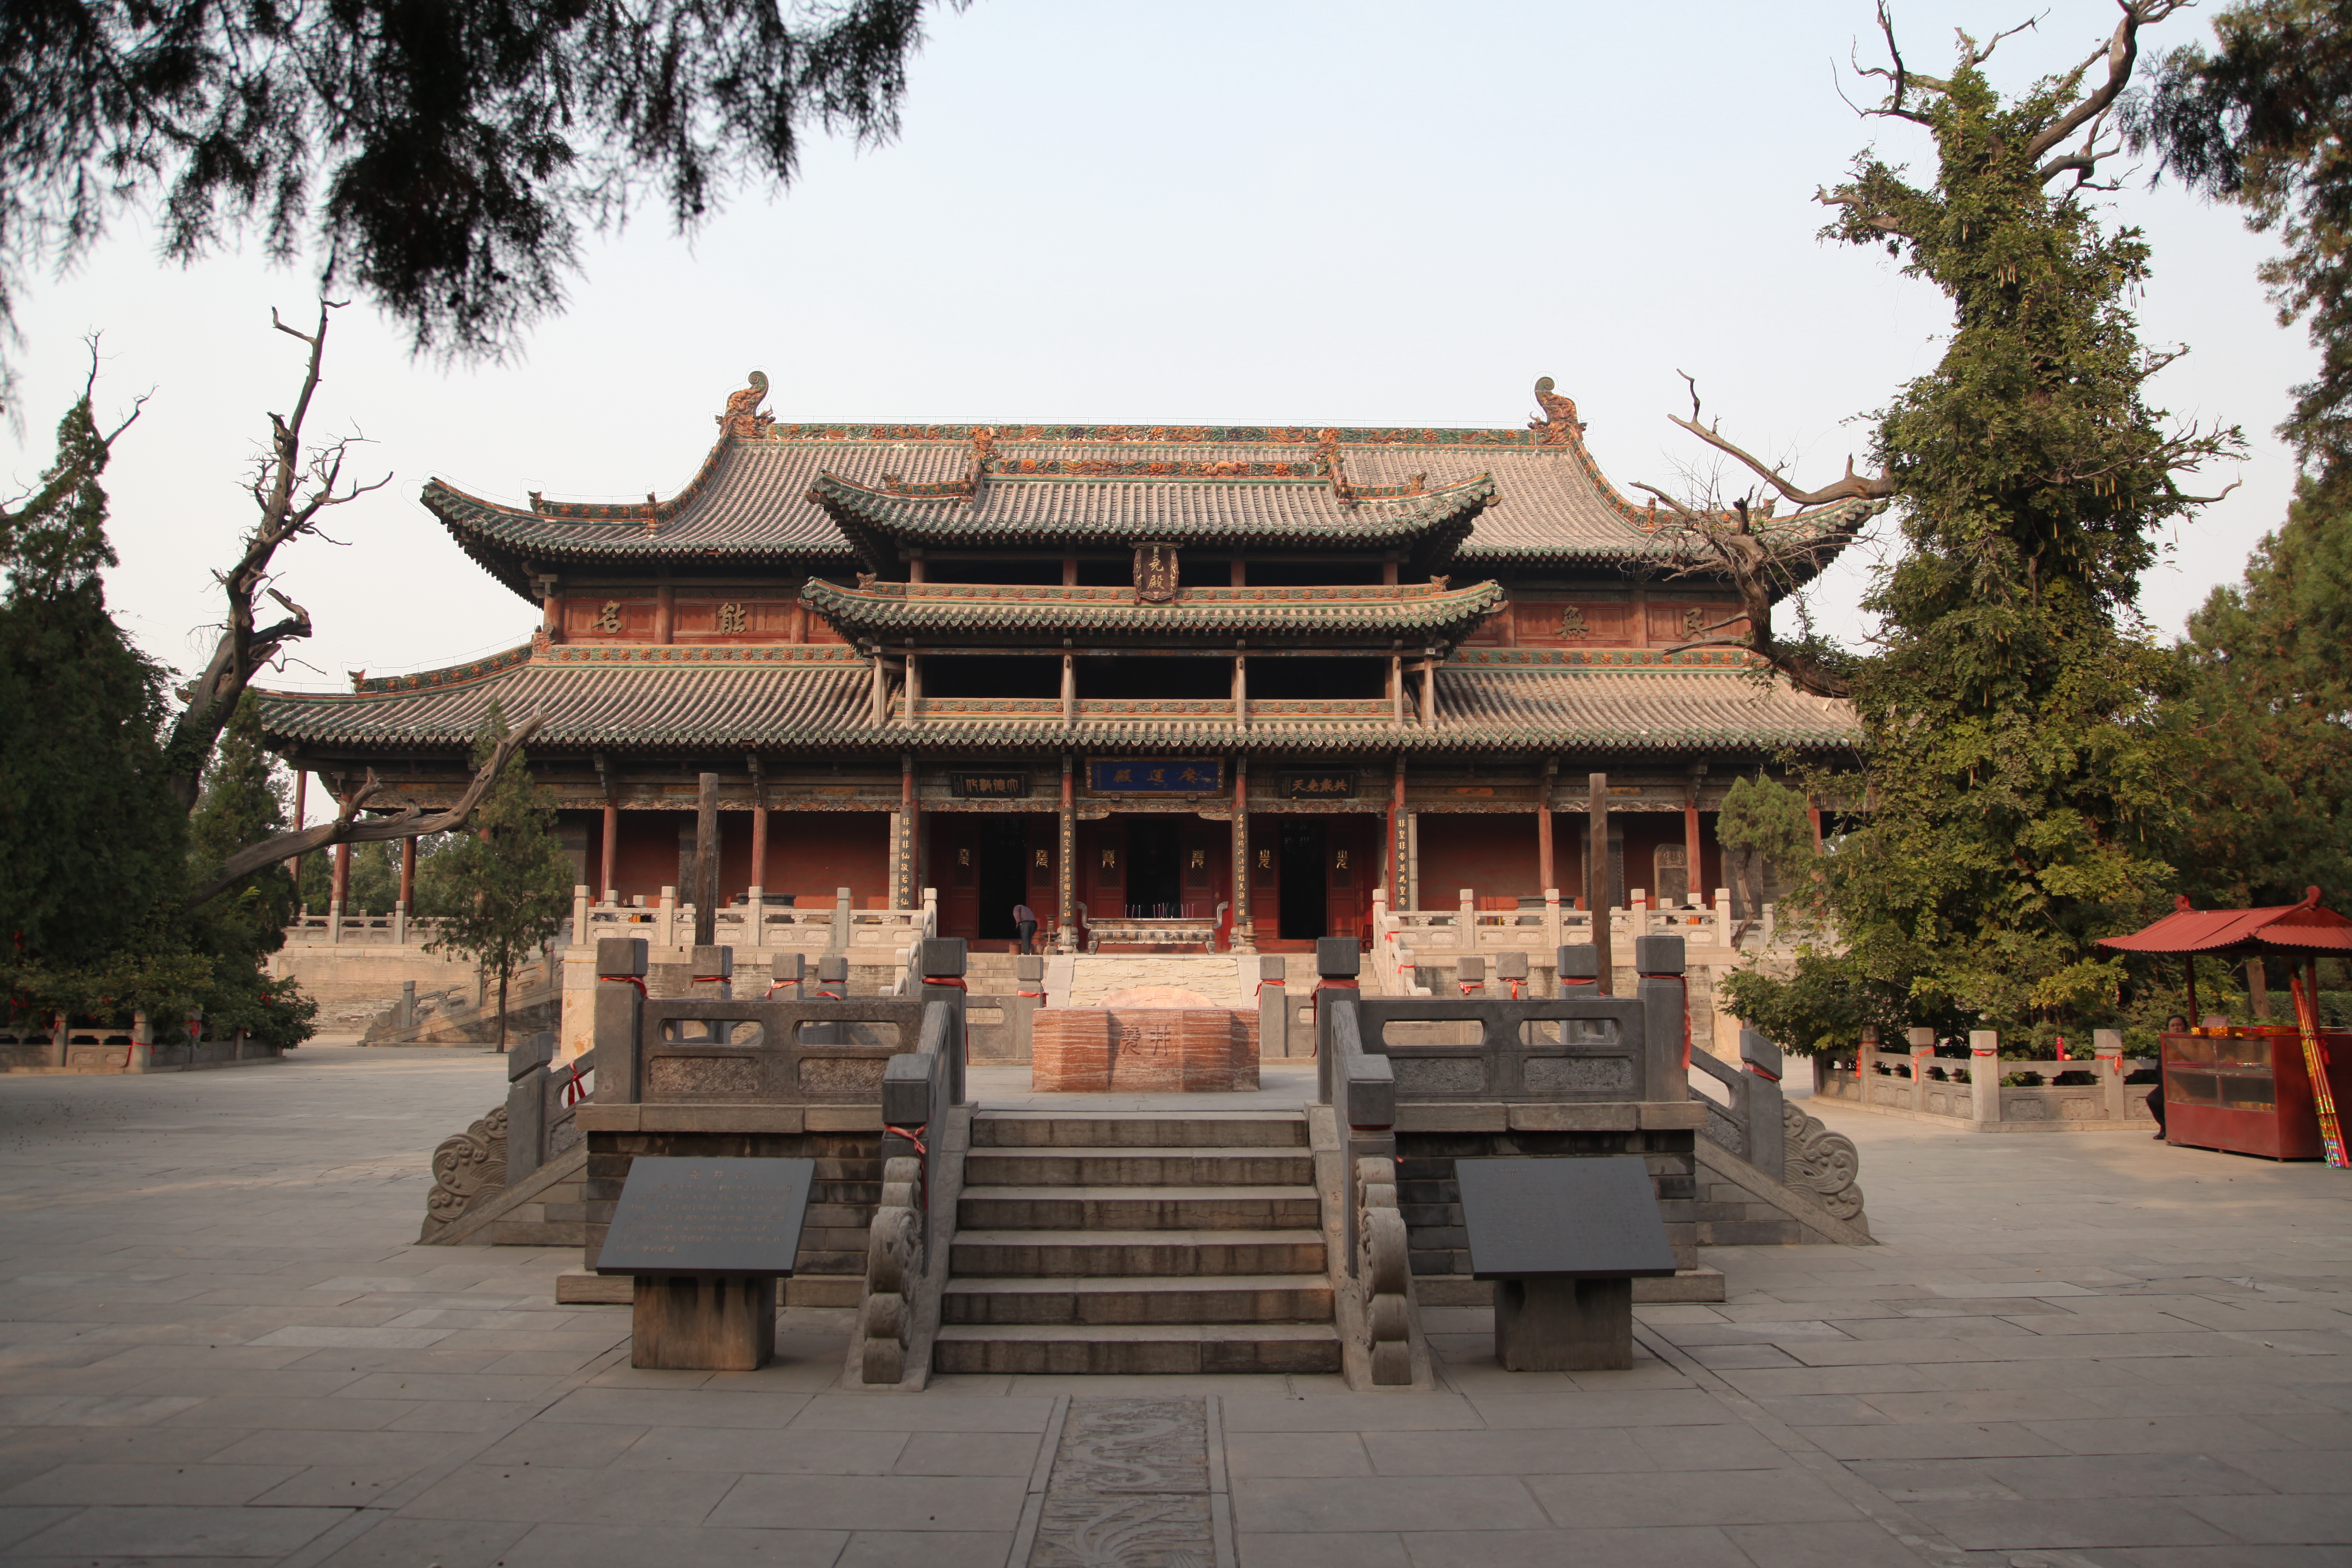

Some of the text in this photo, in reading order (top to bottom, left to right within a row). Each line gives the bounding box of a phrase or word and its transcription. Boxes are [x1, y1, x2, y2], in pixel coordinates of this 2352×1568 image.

[592, 600, 623, 635] 名
[718, 602, 747, 635] 能
[1680, 607, 1706, 640] 民
[900, 817, 910, 906] 非神非仙敬若神仙
[688, 1170, 748, 1180] 尧井台
